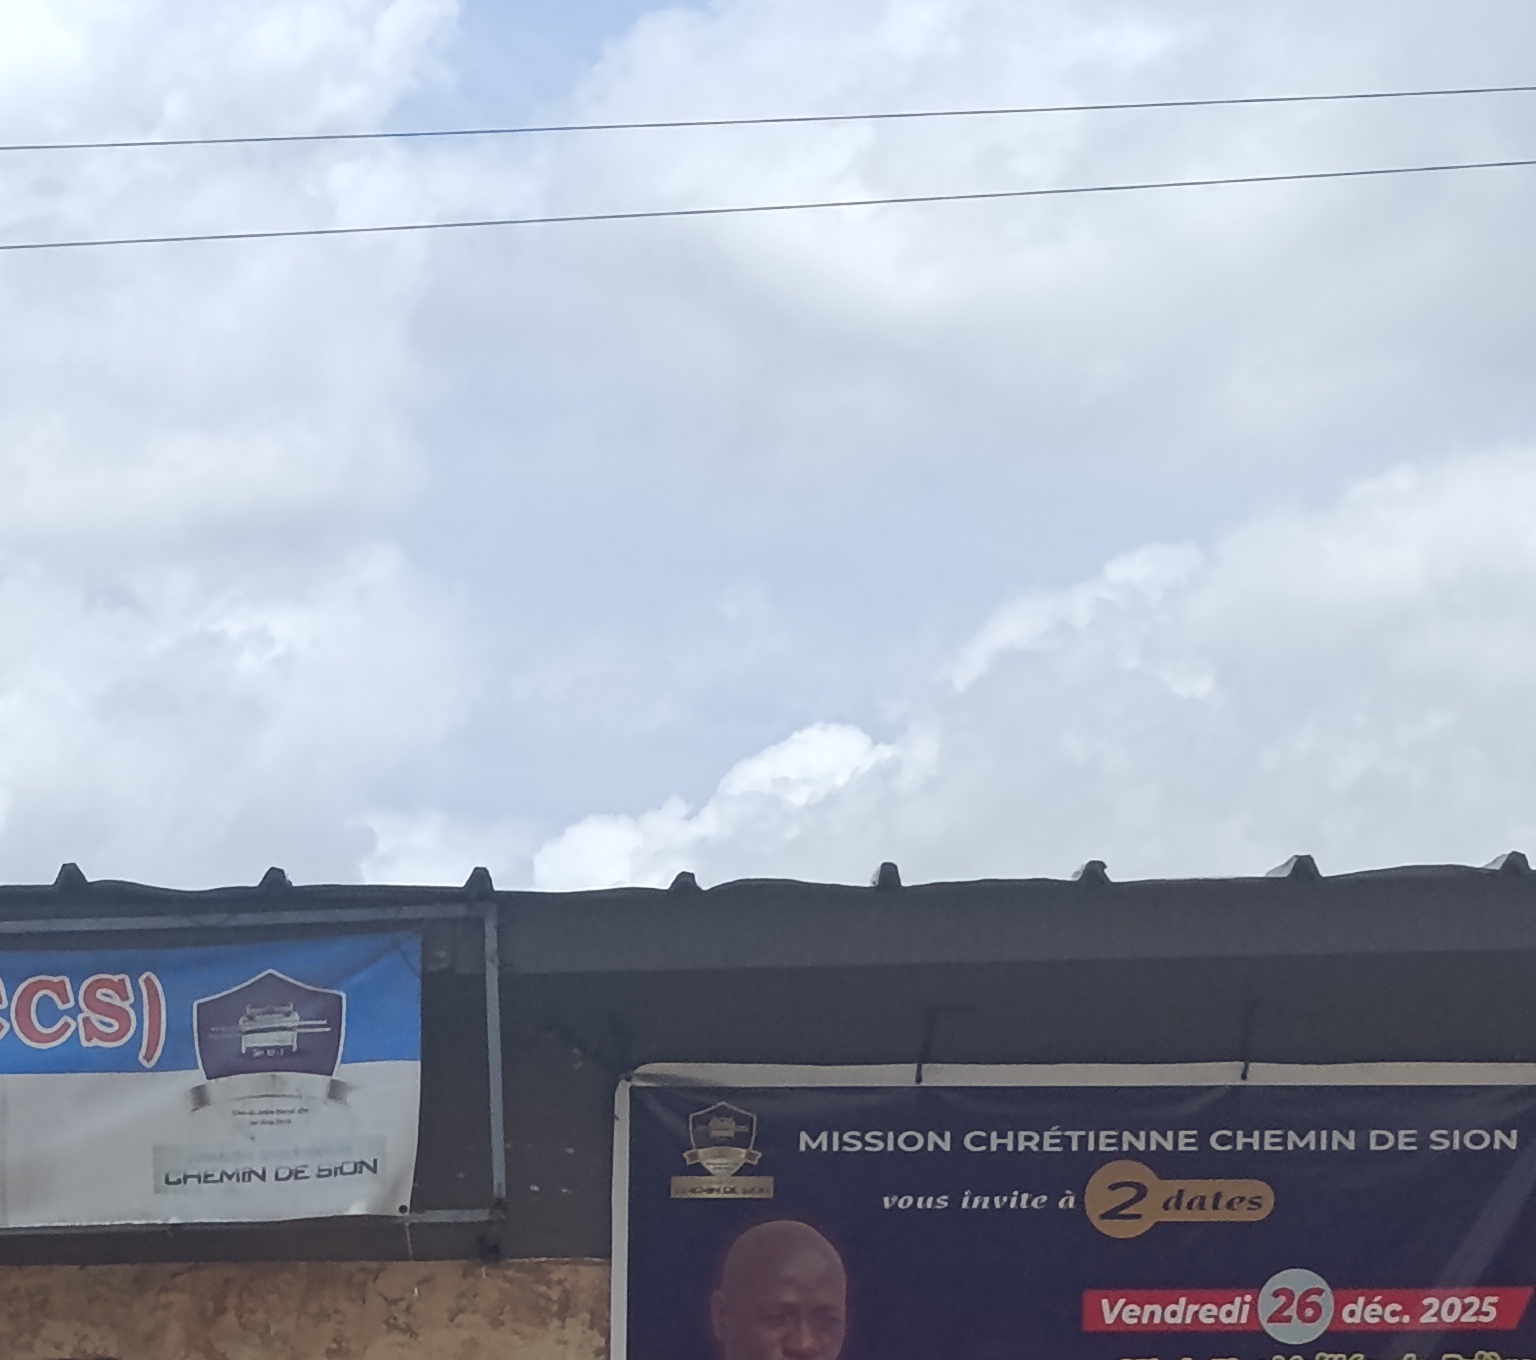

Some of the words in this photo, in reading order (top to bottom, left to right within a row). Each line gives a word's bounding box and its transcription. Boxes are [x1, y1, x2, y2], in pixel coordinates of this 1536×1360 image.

[798, 1130, 951, 1152] MISSION
[963, 1125, 1198, 1152] CHRÉTIENNE
[1209, 1129, 1356, 1151] CHEMIN
[1369, 1129, 1418, 1151] DE
[1428, 1129, 1518, 1151] SION
[274, 1164, 310, 1182] DE
[882, 1193, 949, 1209] vous
[961, 1190, 1047, 1210] invite
[1058, 1190, 1076, 1209] à
[1099, 1180, 1149, 1220] 2
[1162, 1189, 1263, 1212] dates
[1100, 1295, 1252, 1325] Vendredi
[1266, 1287, 1326, 1325] 26
[1342, 1297, 1409, 1325] déc.
[1420, 1297, 1500, 1323] 2025
